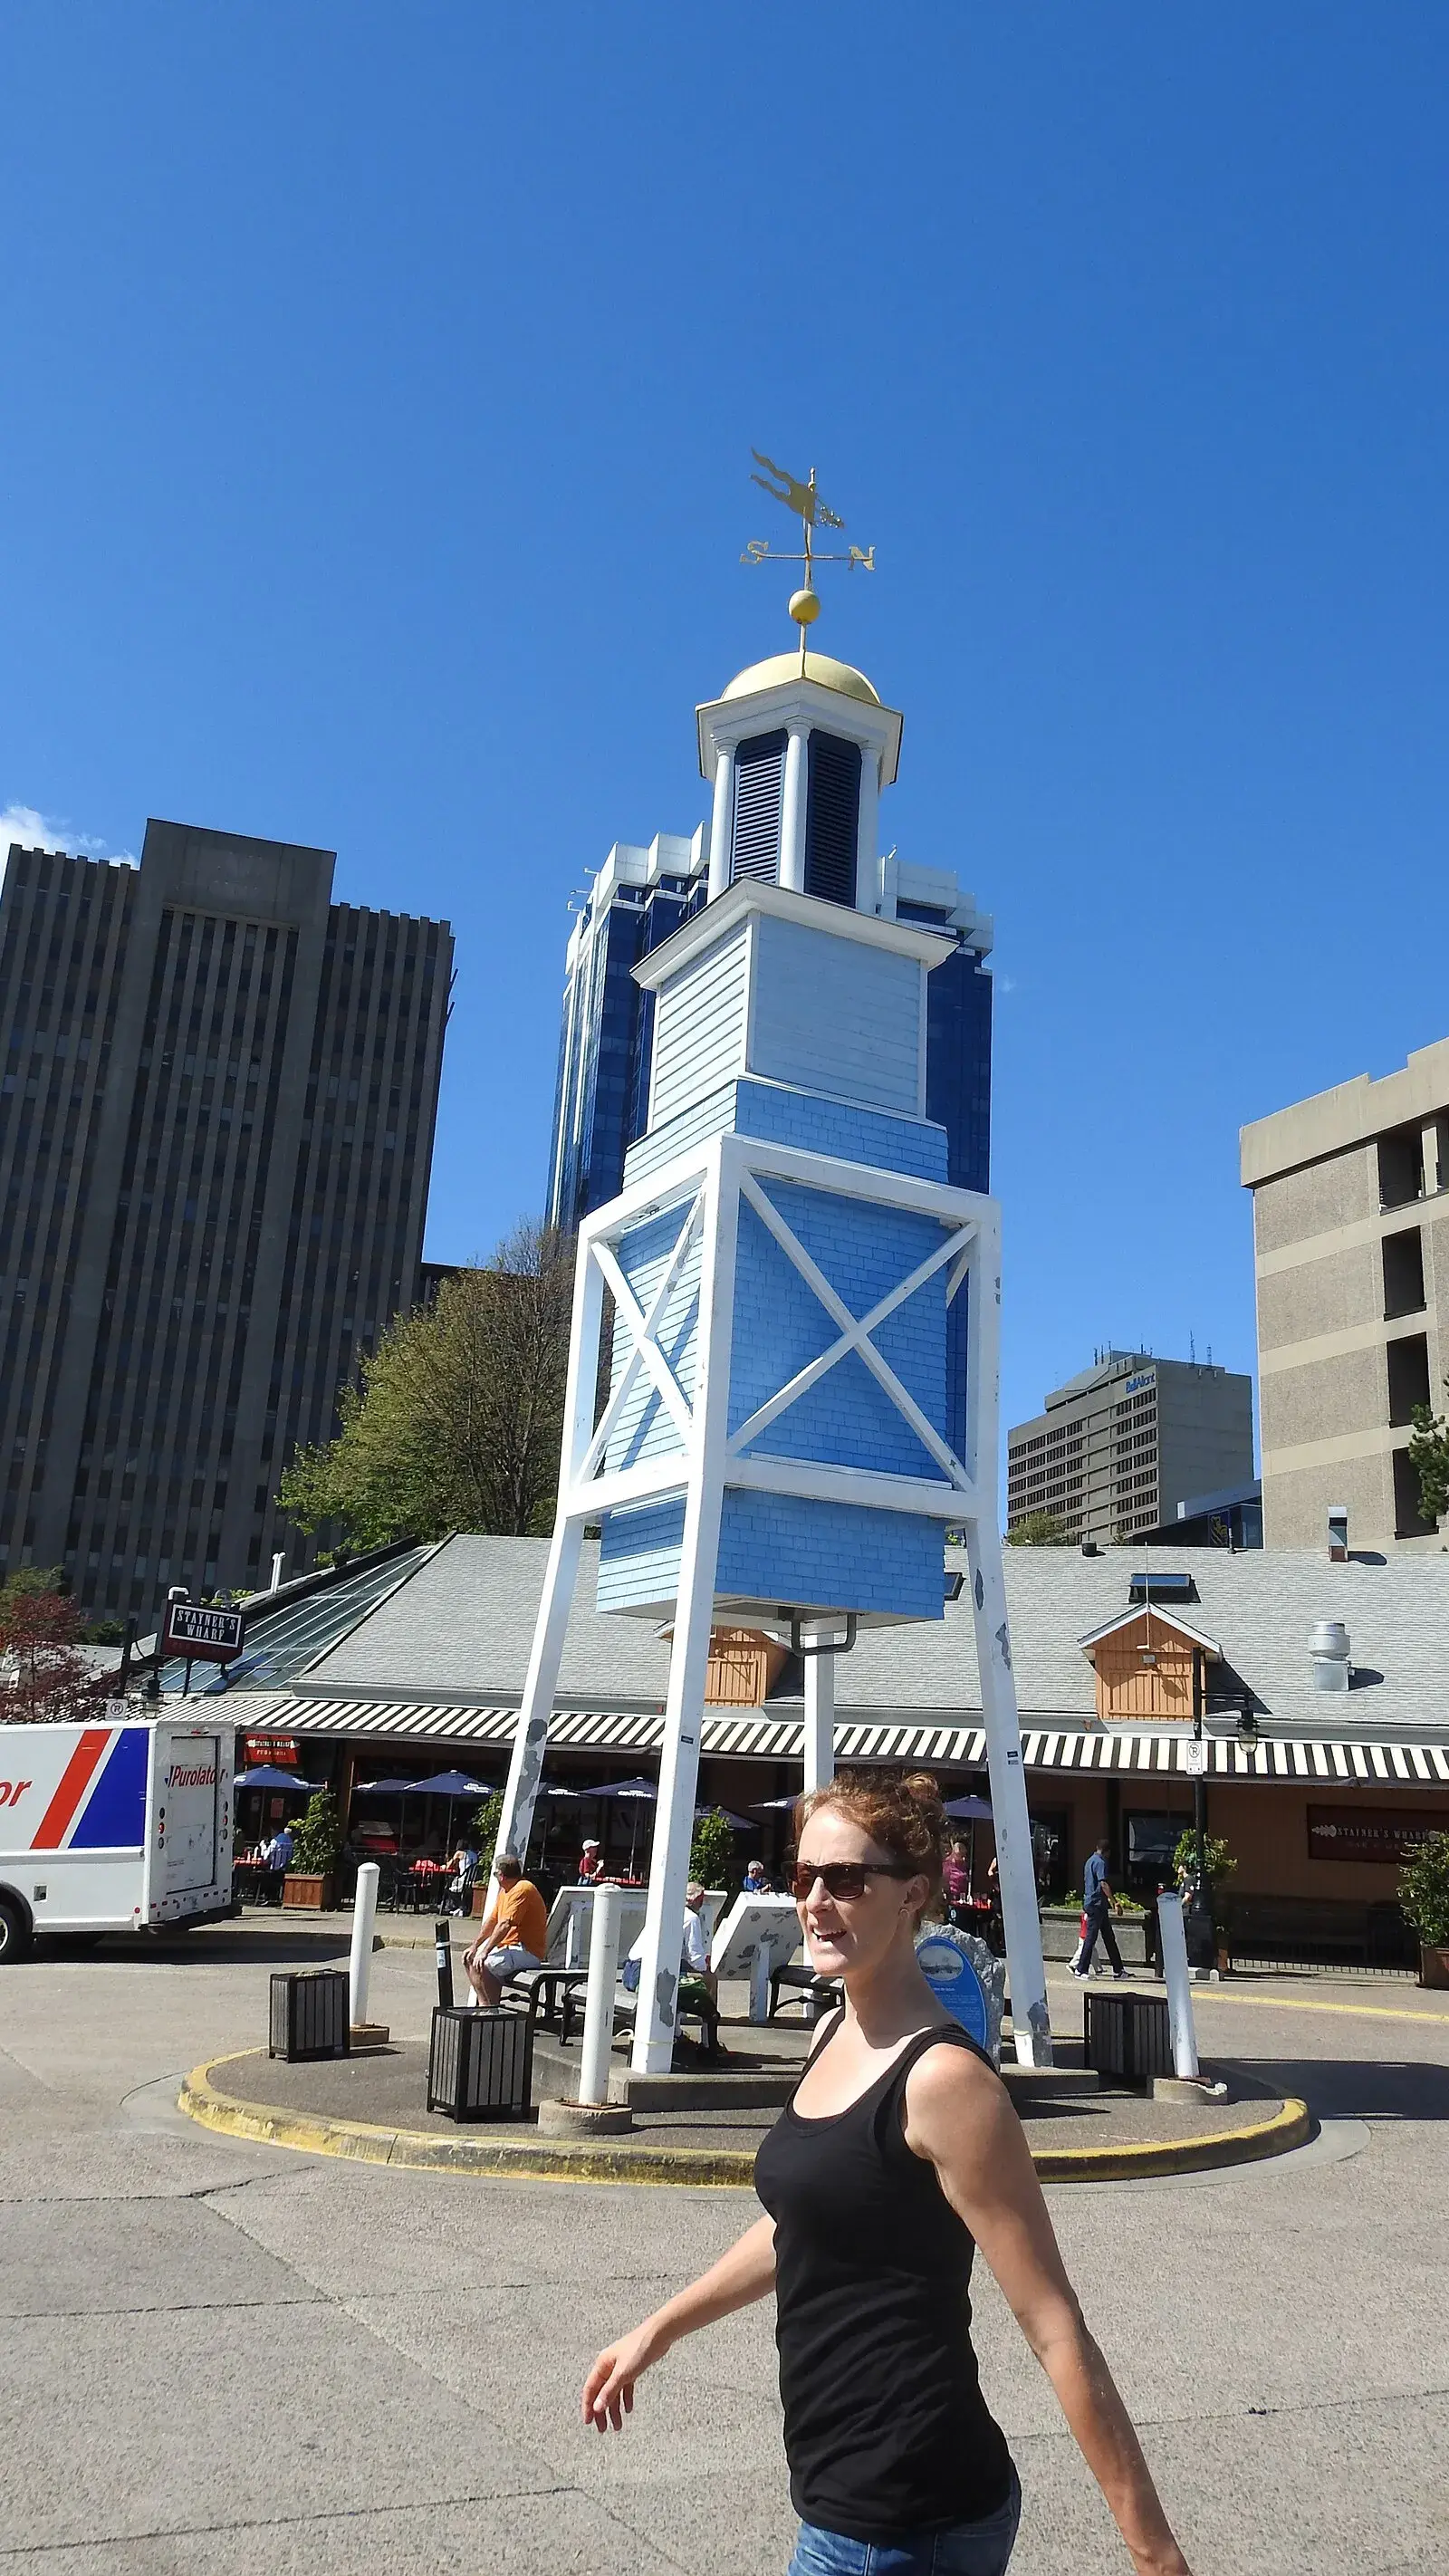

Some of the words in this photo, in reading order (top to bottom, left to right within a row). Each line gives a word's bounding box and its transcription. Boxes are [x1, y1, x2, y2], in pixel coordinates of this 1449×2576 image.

[177, 1610, 236, 1630] STAYNER'S
[187, 1623, 225, 1641] WHARF
[171, 1765, 226, 1788] Purolator
